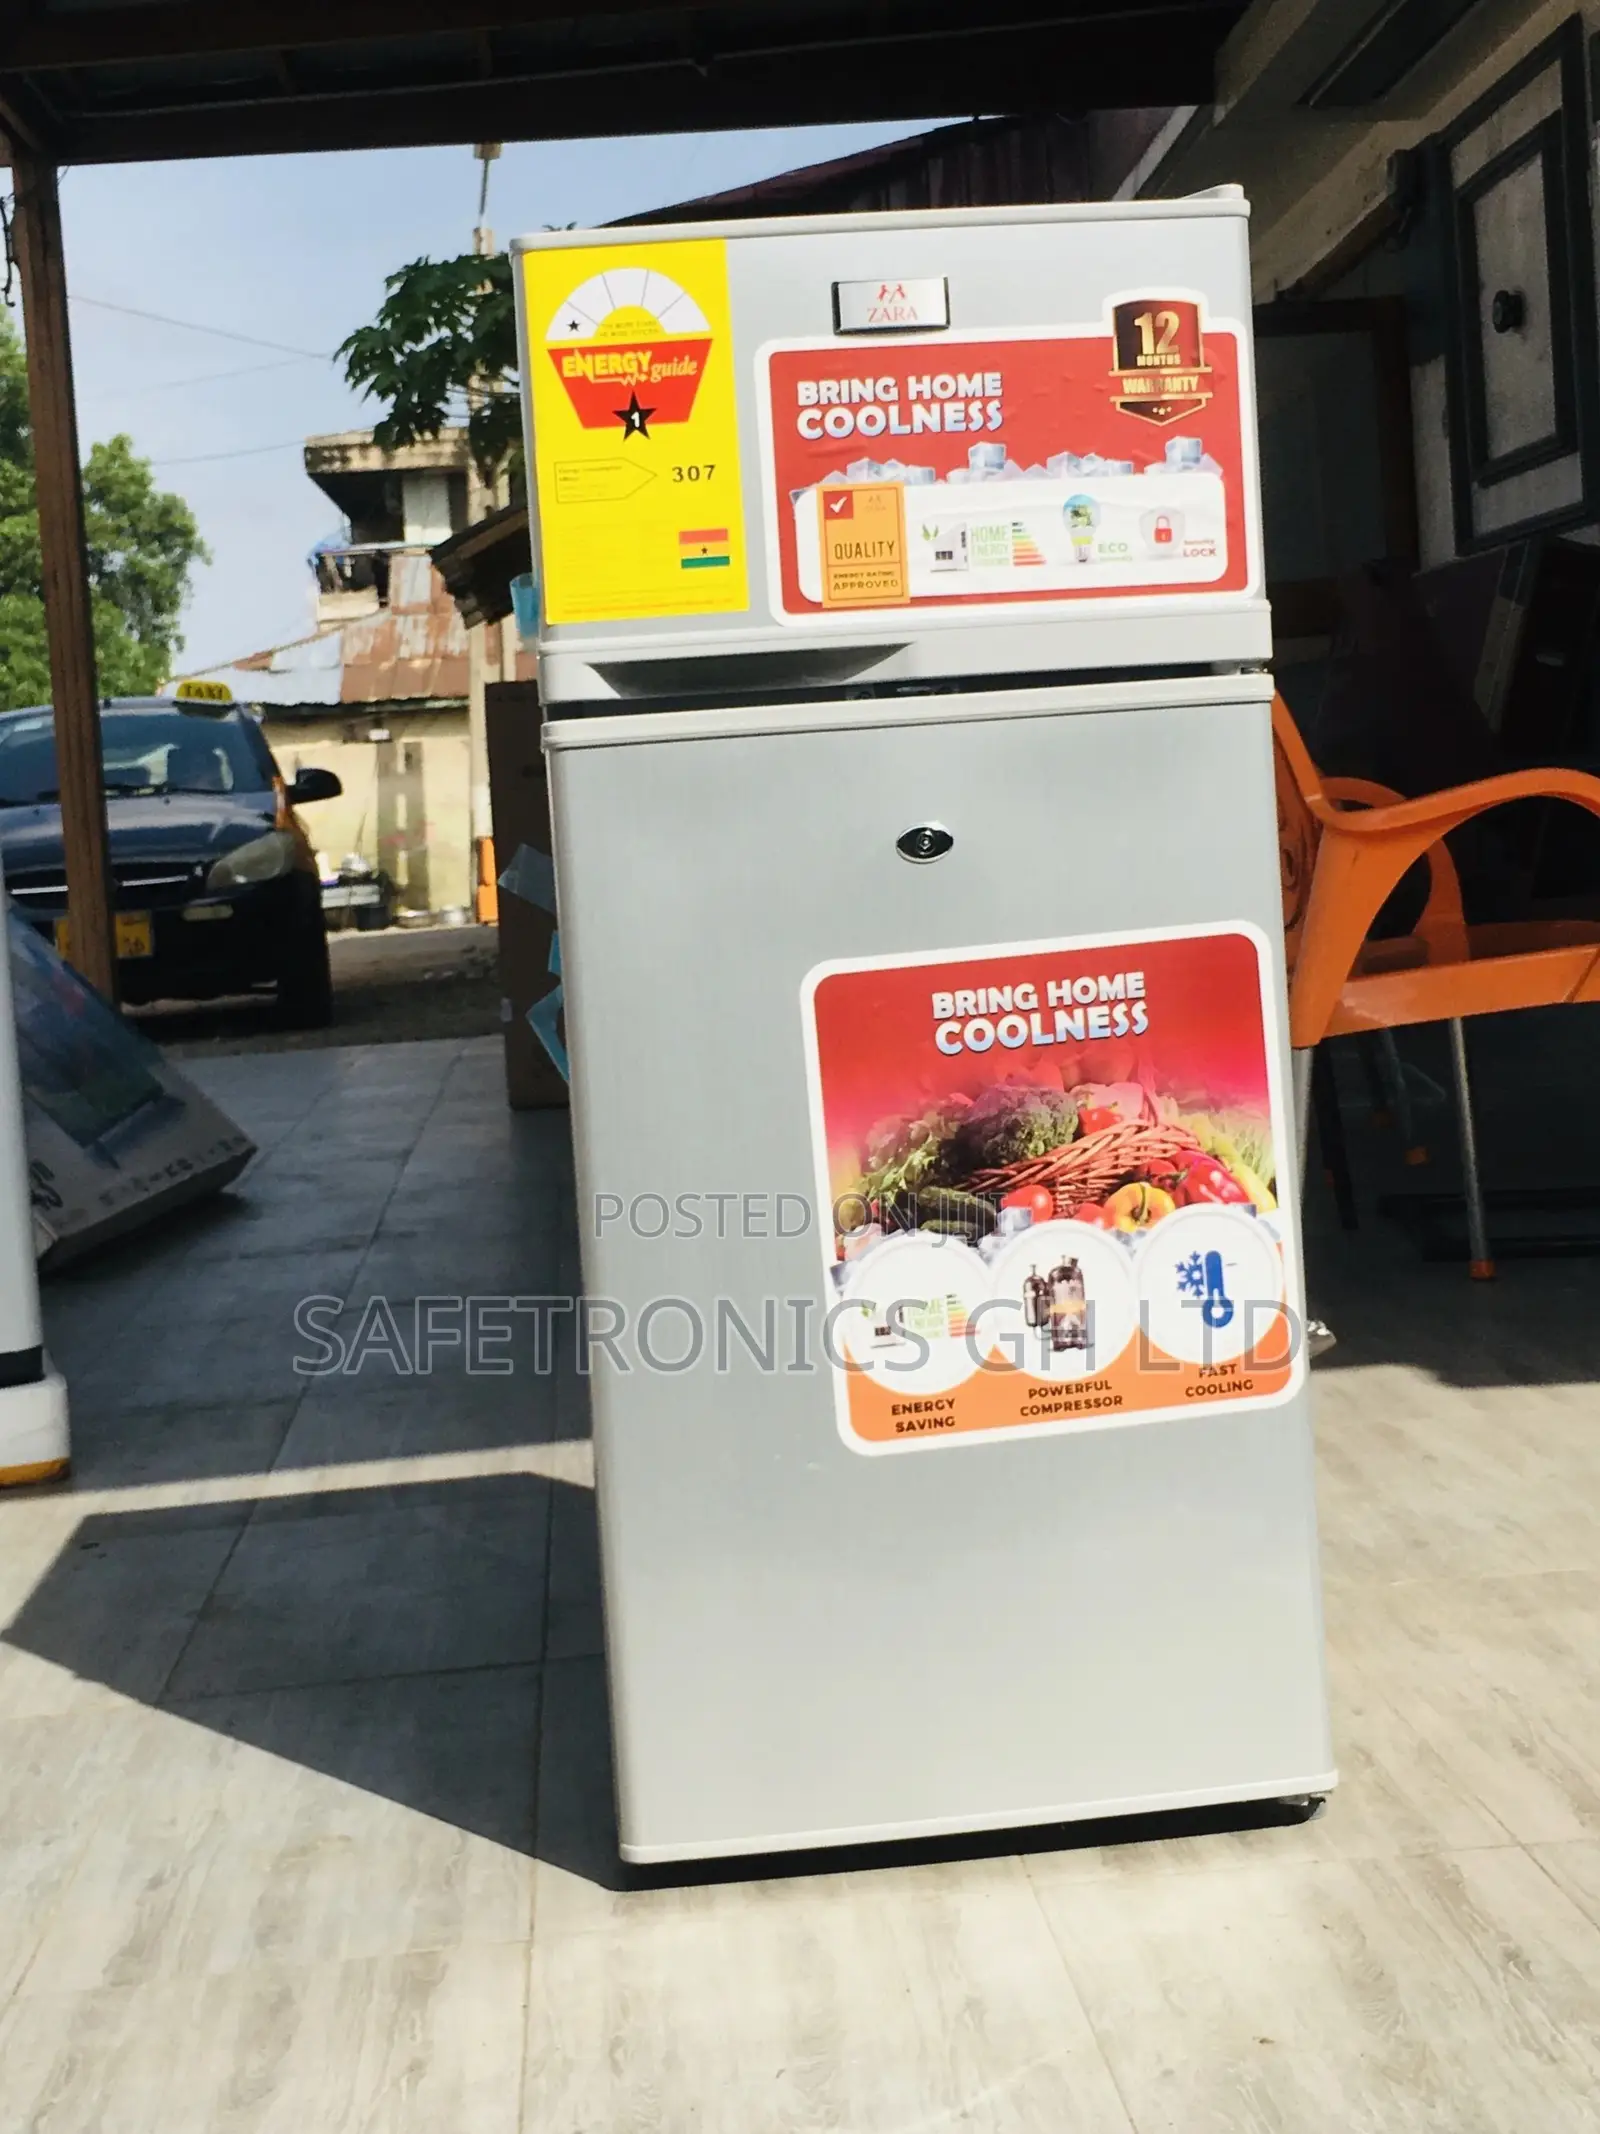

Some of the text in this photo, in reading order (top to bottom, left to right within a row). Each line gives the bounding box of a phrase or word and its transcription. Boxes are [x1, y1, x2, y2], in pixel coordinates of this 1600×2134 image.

[867, 306, 918, 322] ZARA
[1134, 311, 1180, 355] 12
[561, 348, 698, 384] ENERGY guide
[797, 372, 1003, 405] BRING HOME
[630, 411, 640, 428] 1
[796, 400, 1004, 440] COOLNESS
[671, 464, 717, 483] 307
[834, 540, 895, 560] QUALITY
[1097, 542, 1128, 553] ECO
[1182, 548, 1217, 558] LOCK
[833, 580, 899, 591] APPROVED
[185, 684, 224, 699] TAXI
[931, 971, 1146, 1020] BRING HOME
[935, 1001, 1149, 1056] COOLNESS
[1197, 1363, 1238, 1379] FAST
[1028, 1380, 1113, 1399] POWERFUL
[1185, 1378, 1254, 1398] COOLING
[891, 1398, 956, 1416] ENERGY
[1020, 1395, 1124, 1417] COMPRESSOR
[895, 1415, 956, 1434] SAVING
